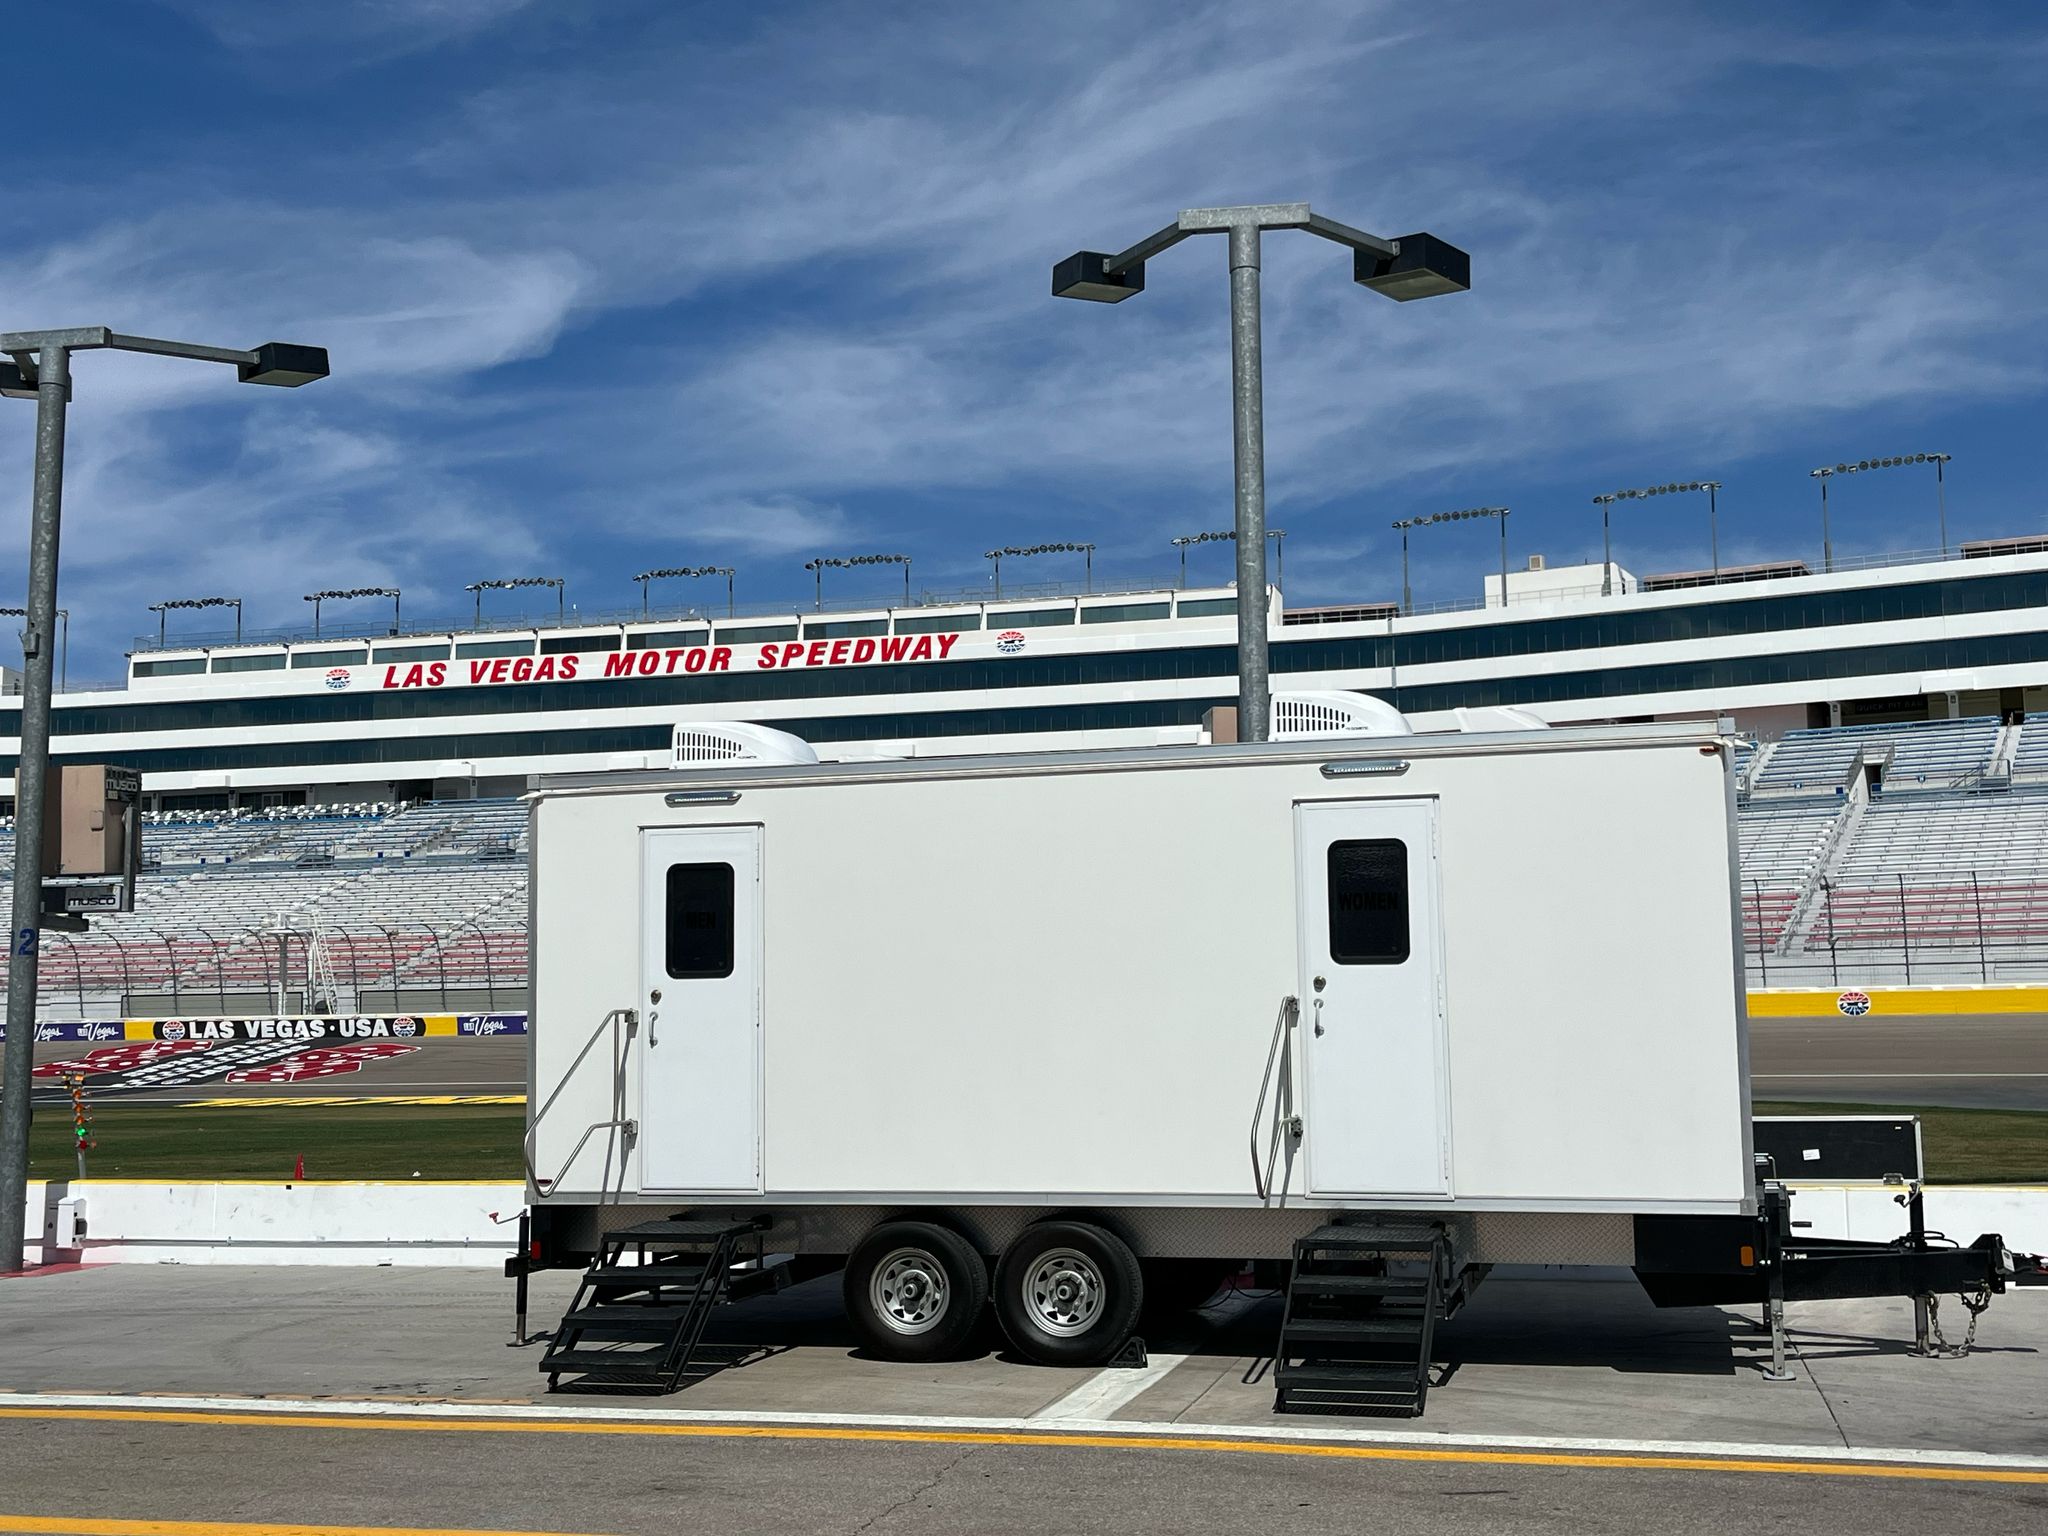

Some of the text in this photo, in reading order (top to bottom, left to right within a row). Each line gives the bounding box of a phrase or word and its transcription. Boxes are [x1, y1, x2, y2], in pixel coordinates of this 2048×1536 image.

[383, 634, 959, 689] LAS VEGAS MOTOR SPEEDWAY
[1340, 892, 1398, 911] WOMEN
[83, 1022, 119, 1041] Vegas
[189, 1018, 389, 1039] LAS VEGAS USA
[470, 1016, 508, 1036] Vegas
